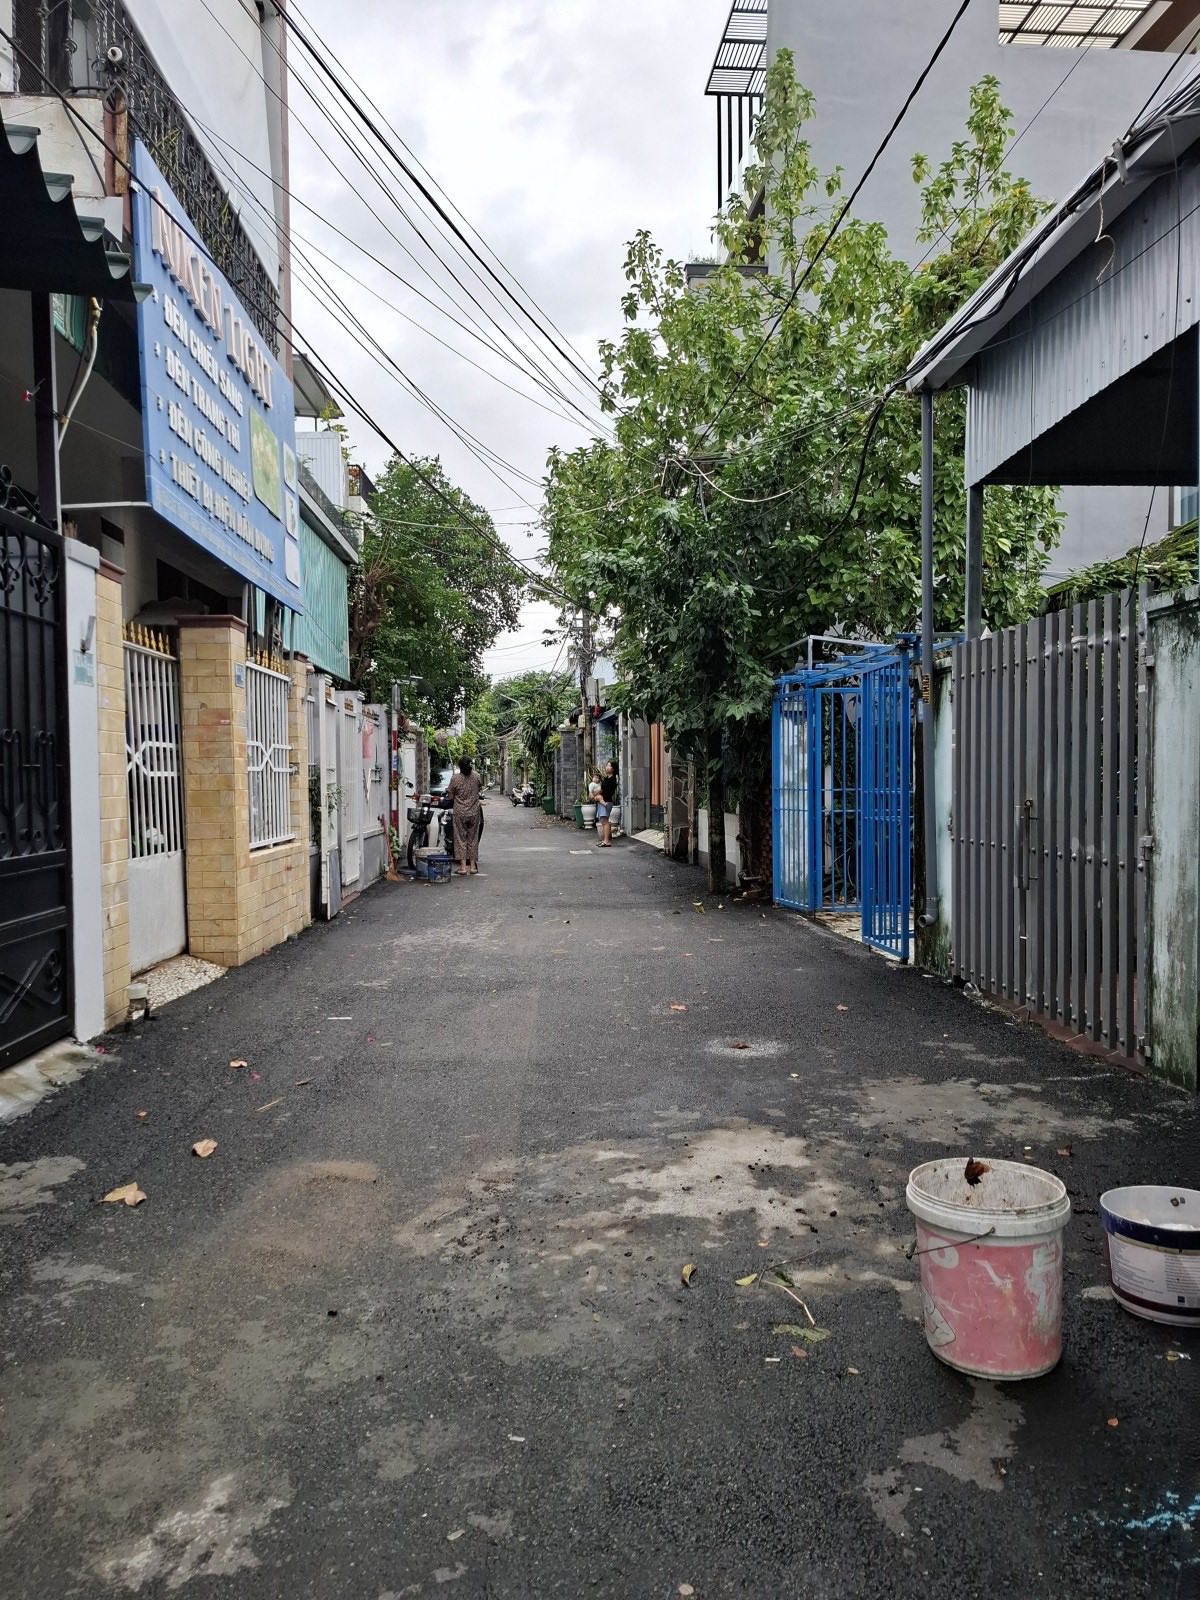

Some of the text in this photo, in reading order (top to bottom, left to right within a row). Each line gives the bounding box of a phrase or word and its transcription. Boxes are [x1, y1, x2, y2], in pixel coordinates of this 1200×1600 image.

[163, 293, 243, 417] ĐÈN CHIẾU SÁNG
[165, 346, 240, 453] ĐÈN TRANG TRÍ
[224, 304, 272, 406] LIGHT
[168, 400, 193, 448] ĐÈN
[193, 427, 221, 476] CÔNG
[170, 451, 200, 502] THIẾT
